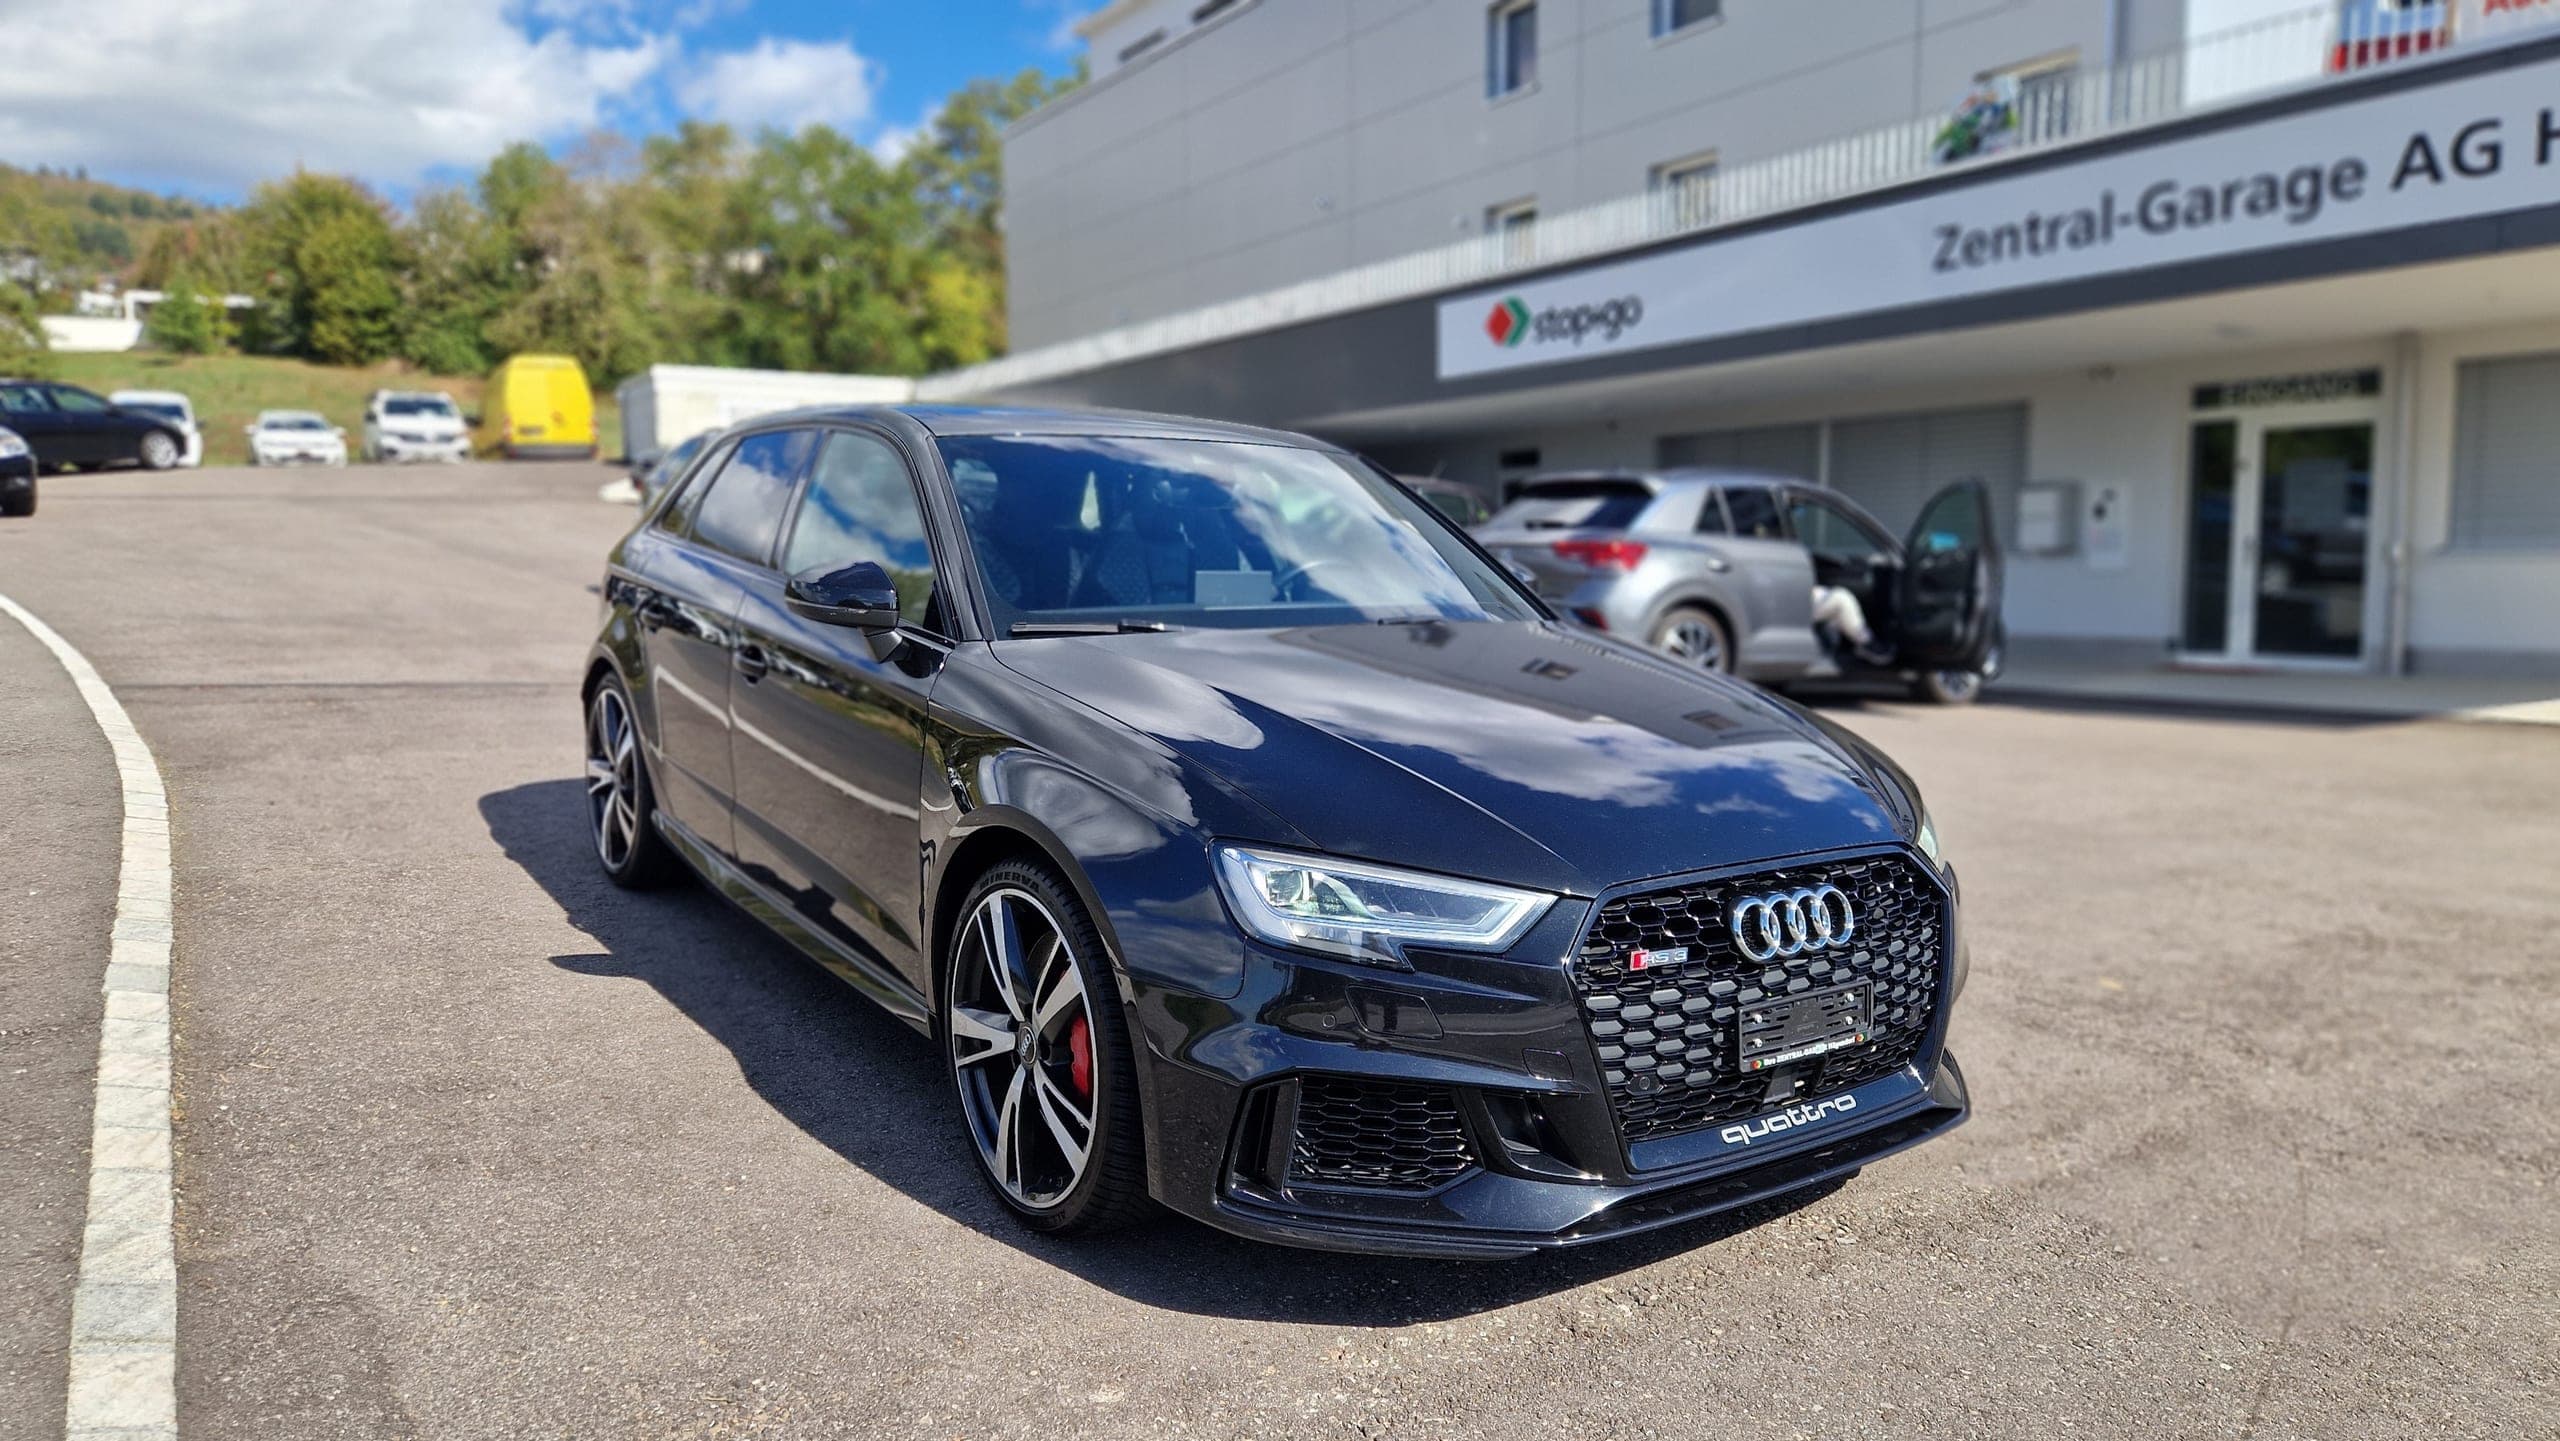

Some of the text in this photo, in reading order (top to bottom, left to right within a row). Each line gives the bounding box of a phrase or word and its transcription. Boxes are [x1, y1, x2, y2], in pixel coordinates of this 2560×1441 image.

[1932, 157, 2367, 273] Zentral-Garage
[2390, 119, 2503, 191] AG
[980, 871, 1041, 893] MINERVA
[1721, 1094, 1857, 1145] quattro
